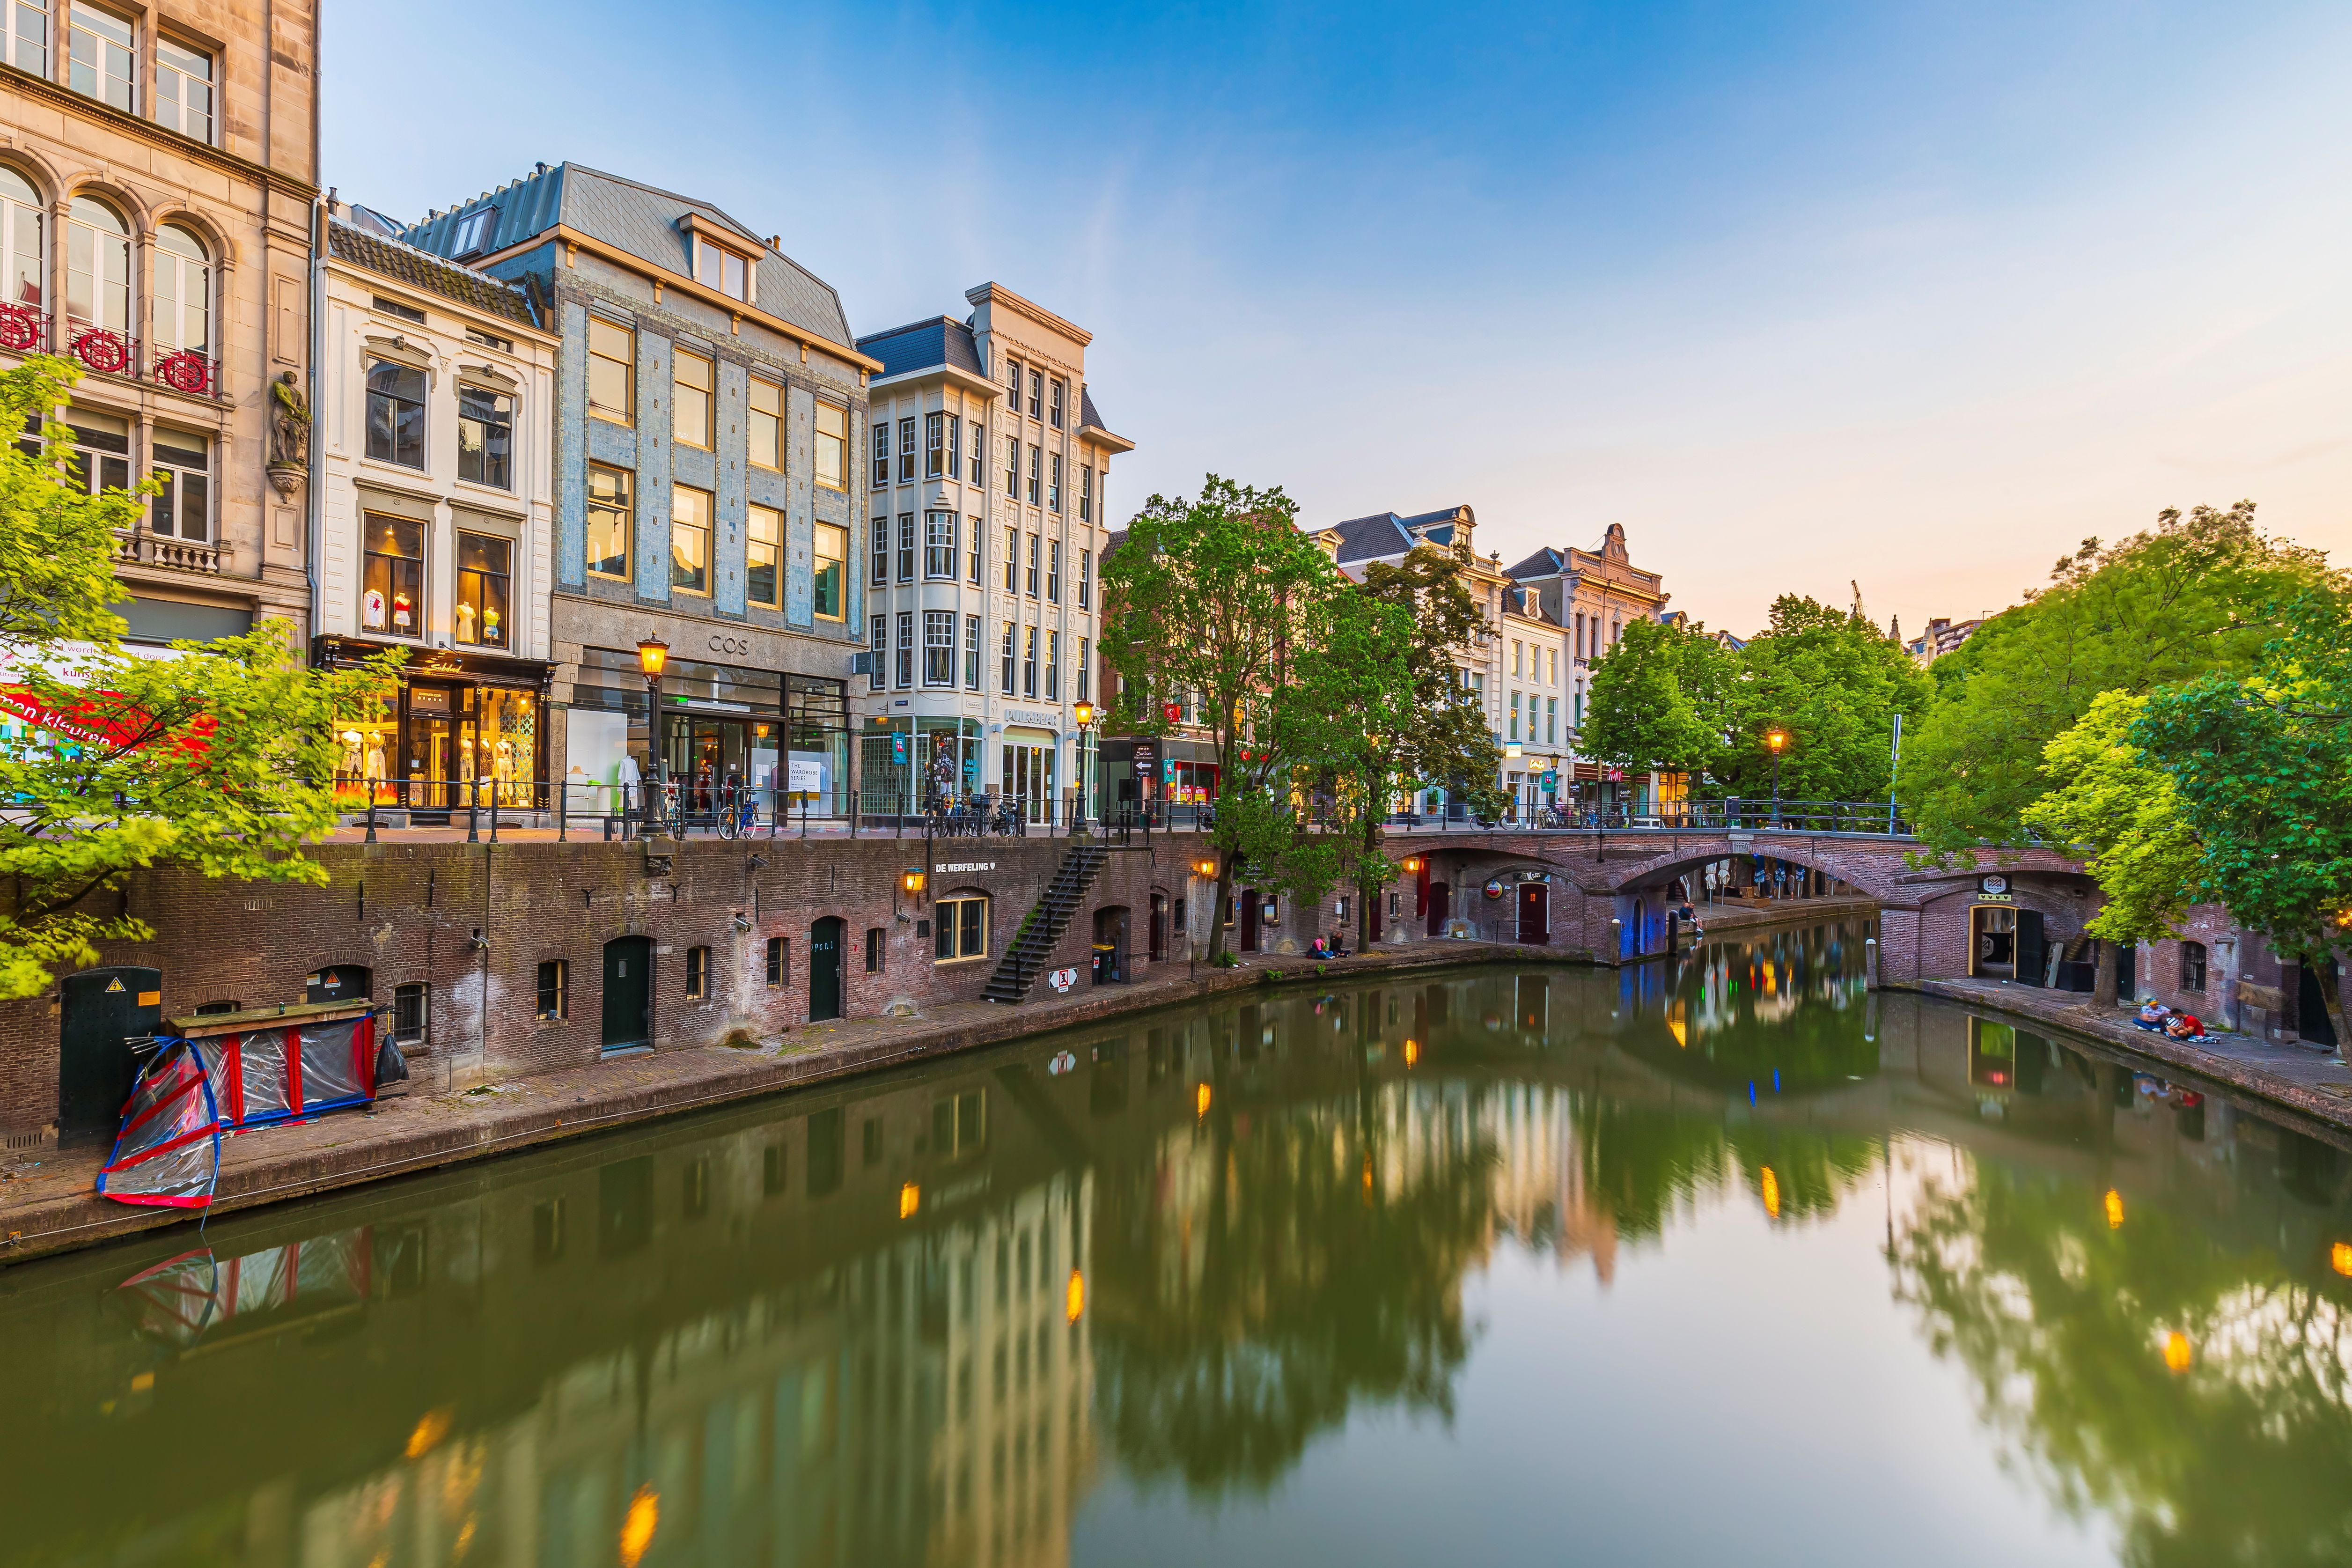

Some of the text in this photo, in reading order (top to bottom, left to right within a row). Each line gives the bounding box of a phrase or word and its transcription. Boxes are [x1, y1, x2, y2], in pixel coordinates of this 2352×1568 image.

[708, 635, 749, 656] COS
[143, 652, 166, 661] door
[426, 662, 462, 674] Subdued
[1004, 708, 1058, 726] PULL&BEAR
[935, 862, 988, 873] DE WERFELING
